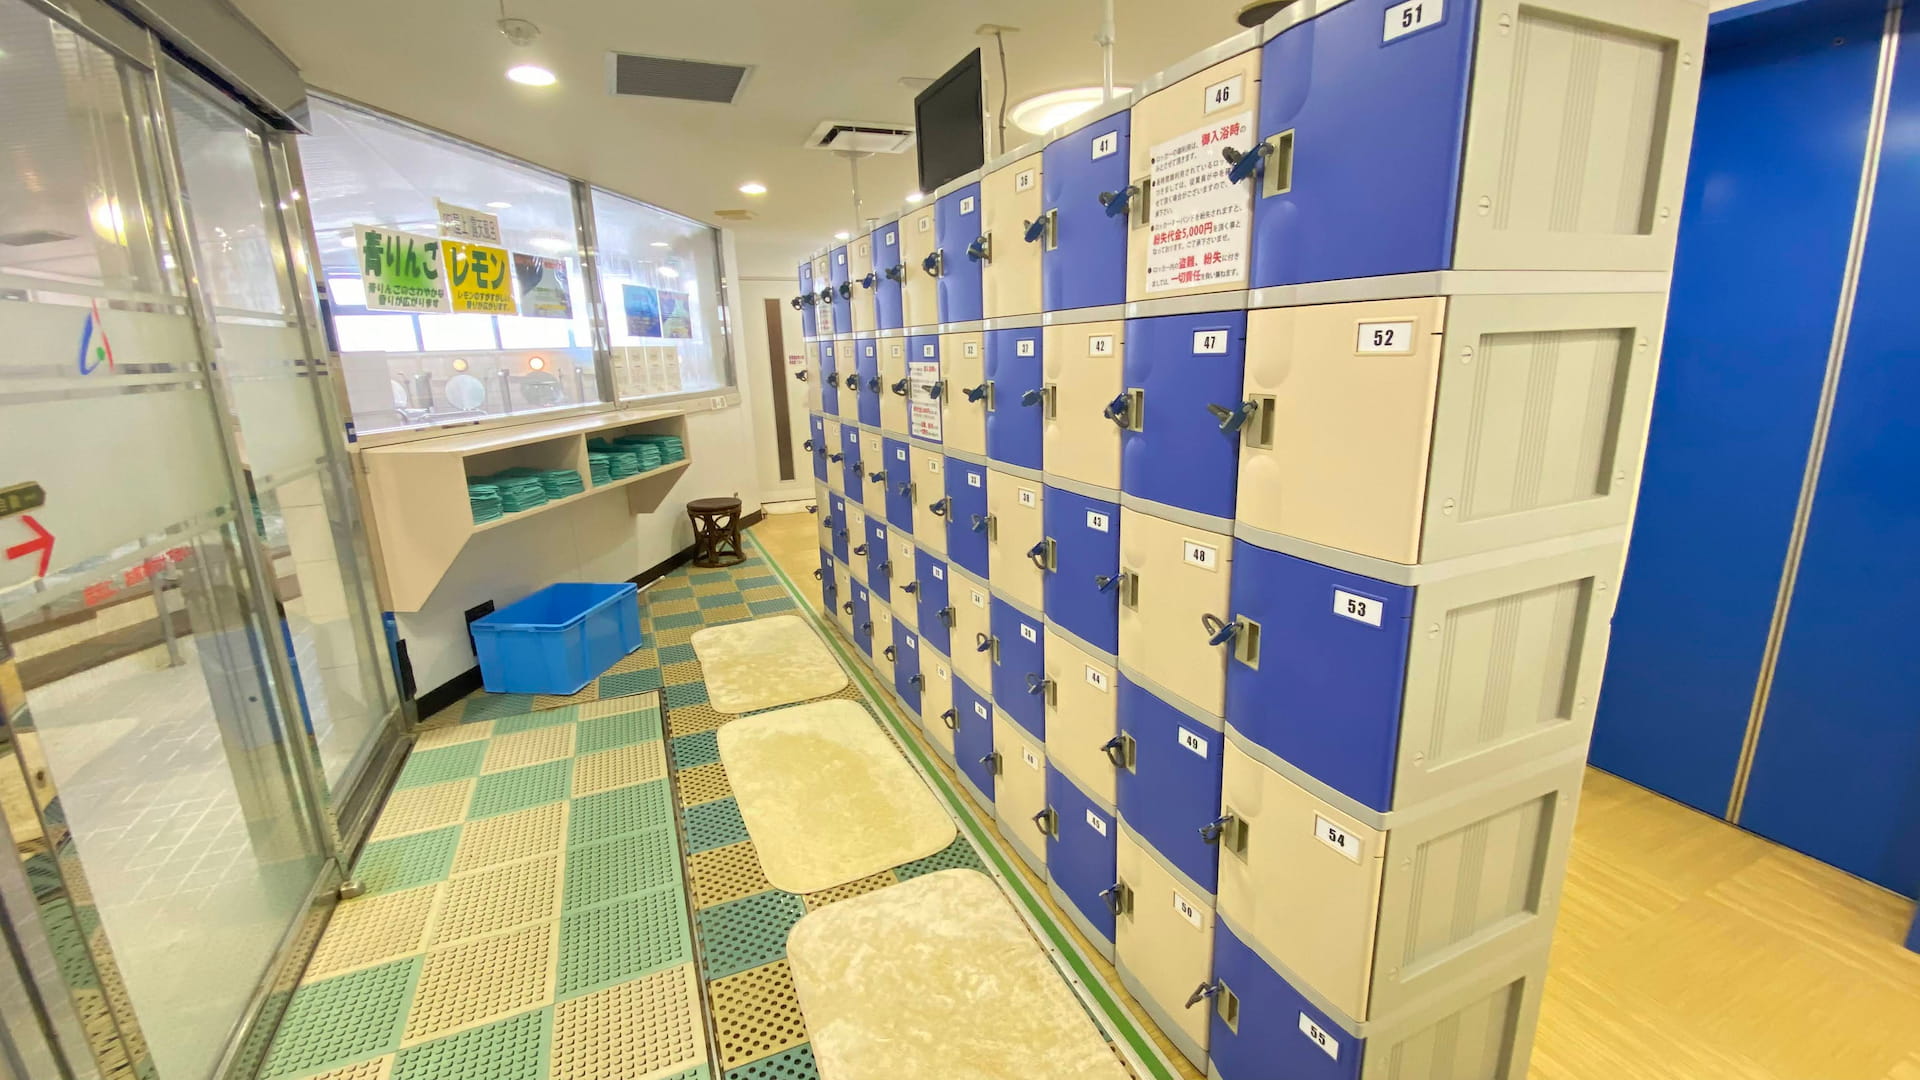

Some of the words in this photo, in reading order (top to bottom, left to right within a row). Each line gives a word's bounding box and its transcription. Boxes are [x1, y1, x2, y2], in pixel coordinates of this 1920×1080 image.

[1402, 4, 1422, 27] 51
[1216, 86, 1229, 103] 46
[1100, 140, 1108, 152] 41
[1020, 176, 1028, 186] 36
[452, 247, 504, 289] レモン
[1204, 336, 1216, 349] 47
[1374, 330, 1394, 346] 52
[1022, 344, 1028, 353] 37
[1096, 340, 1104, 352] 42
[1092, 516, 1101, 527] 43
[1194, 548, 1205, 562] 48
[1348, 599, 1366, 617] 53
[1092, 674, 1100, 684] 44
[1186, 736, 1198, 750] 49
[1092, 817, 1100, 829] 45
[1329, 828, 1345, 847] 54
[1182, 902, 1192, 918] 50
[1310, 1025, 1326, 1046] 55
